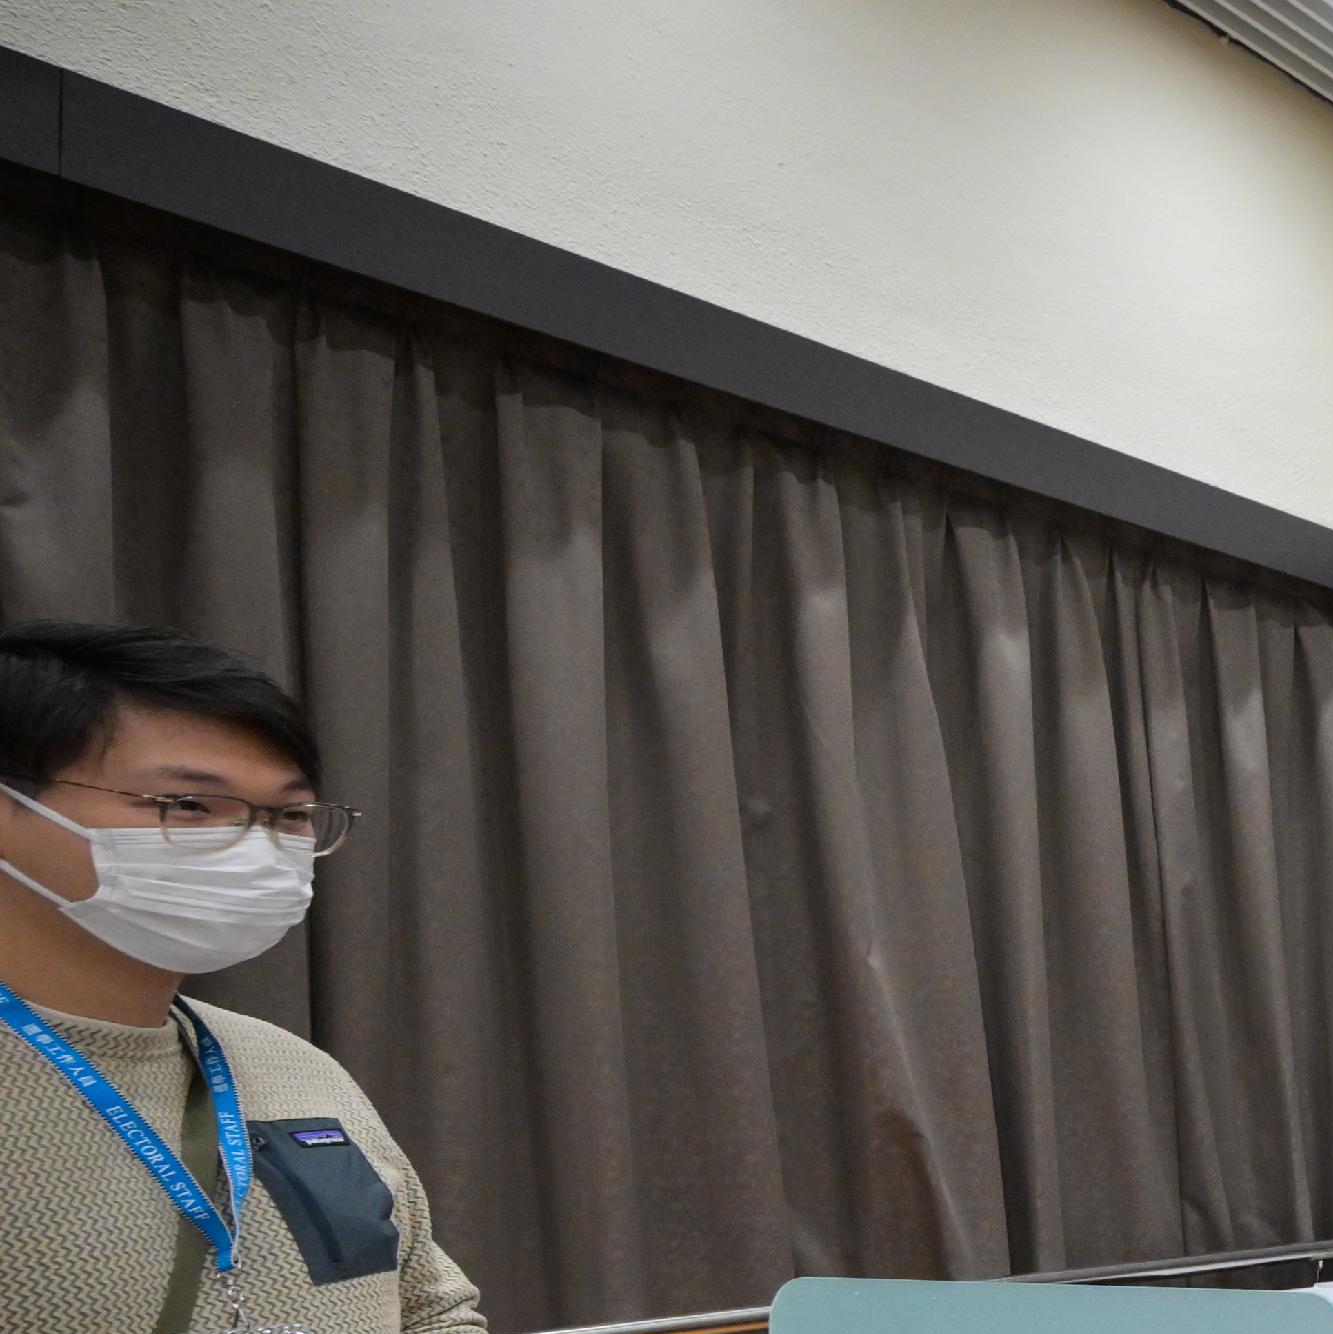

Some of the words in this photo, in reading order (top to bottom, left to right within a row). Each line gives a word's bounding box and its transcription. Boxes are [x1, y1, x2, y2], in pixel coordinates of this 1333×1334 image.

[106, 1105, 172, 1183] ELECTORAL
[170, 1181, 211, 1222] STAFF
[219, 1111, 243, 1148] STAFF
